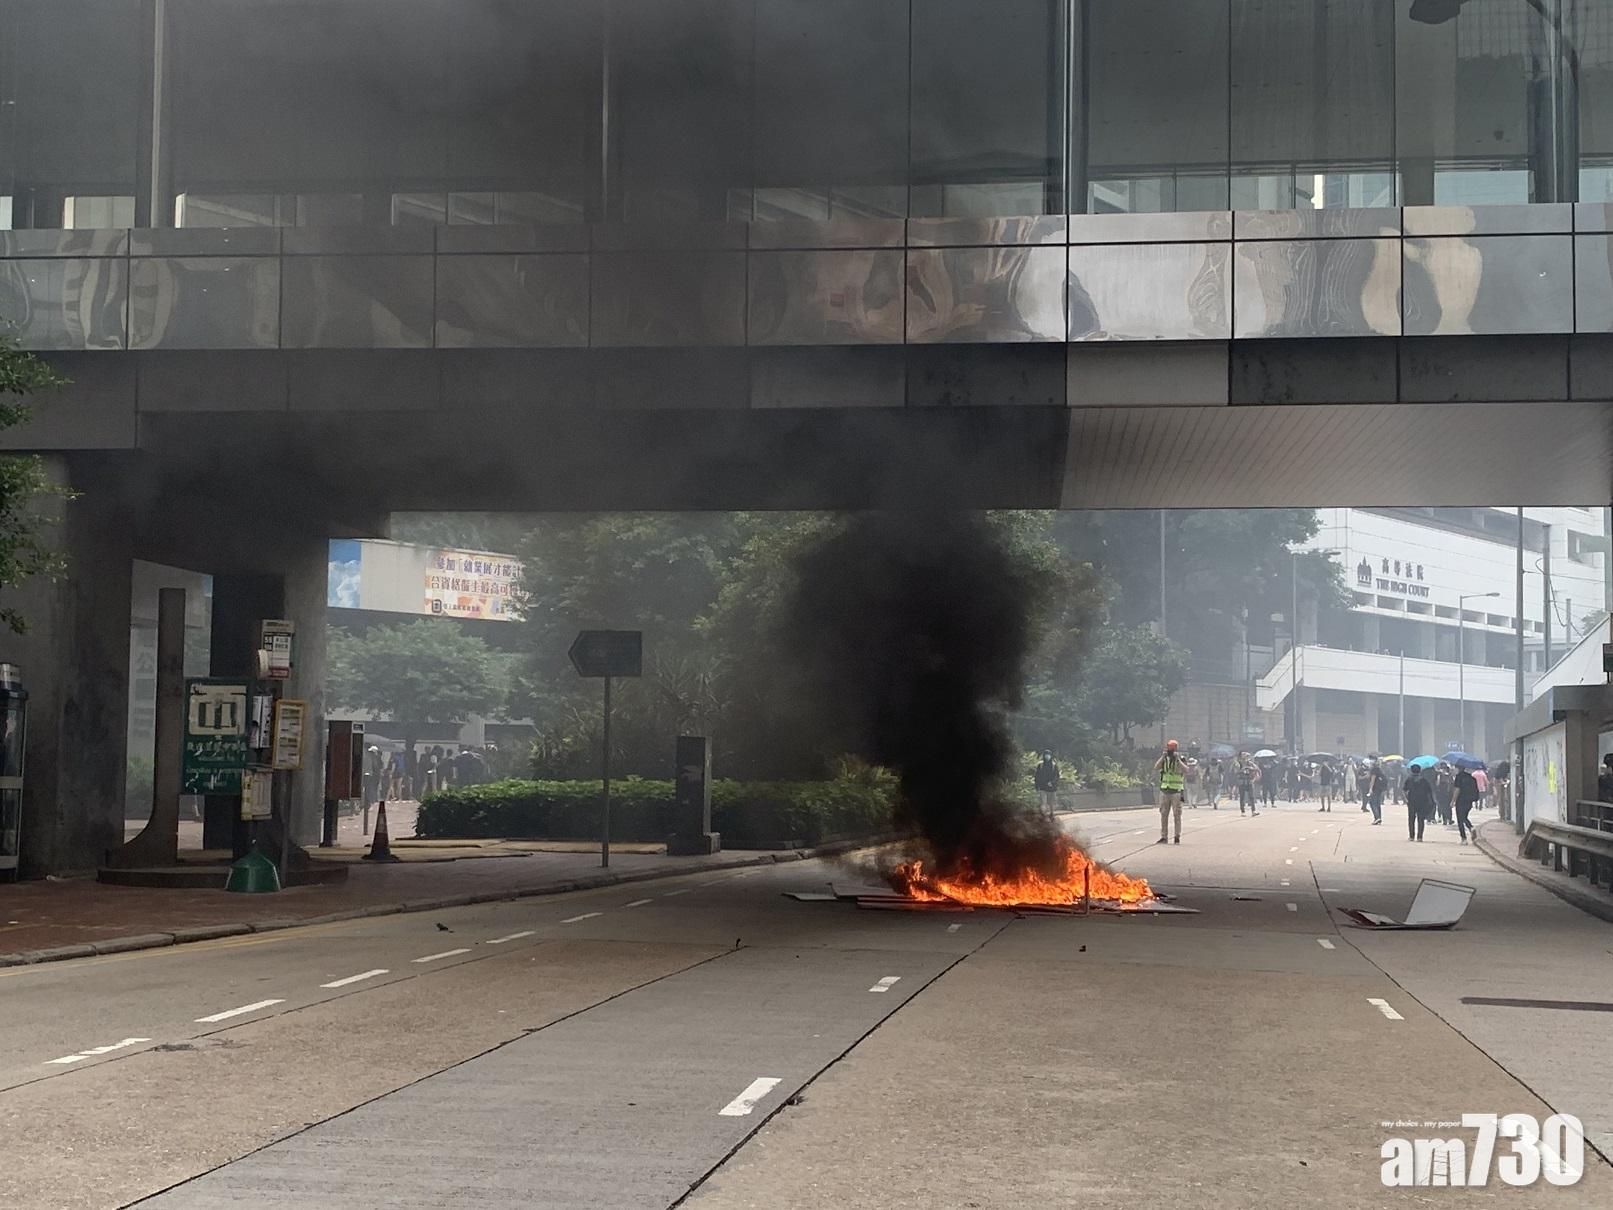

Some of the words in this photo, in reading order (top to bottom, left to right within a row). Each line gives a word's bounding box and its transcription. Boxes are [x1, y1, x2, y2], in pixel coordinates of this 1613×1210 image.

[1382, 557, 1424, 581] 高等法院
[1376, 578, 1390, 591] THE
[1391, 580, 1407, 594] HIGH
[1408, 584, 1430, 598] COURT
